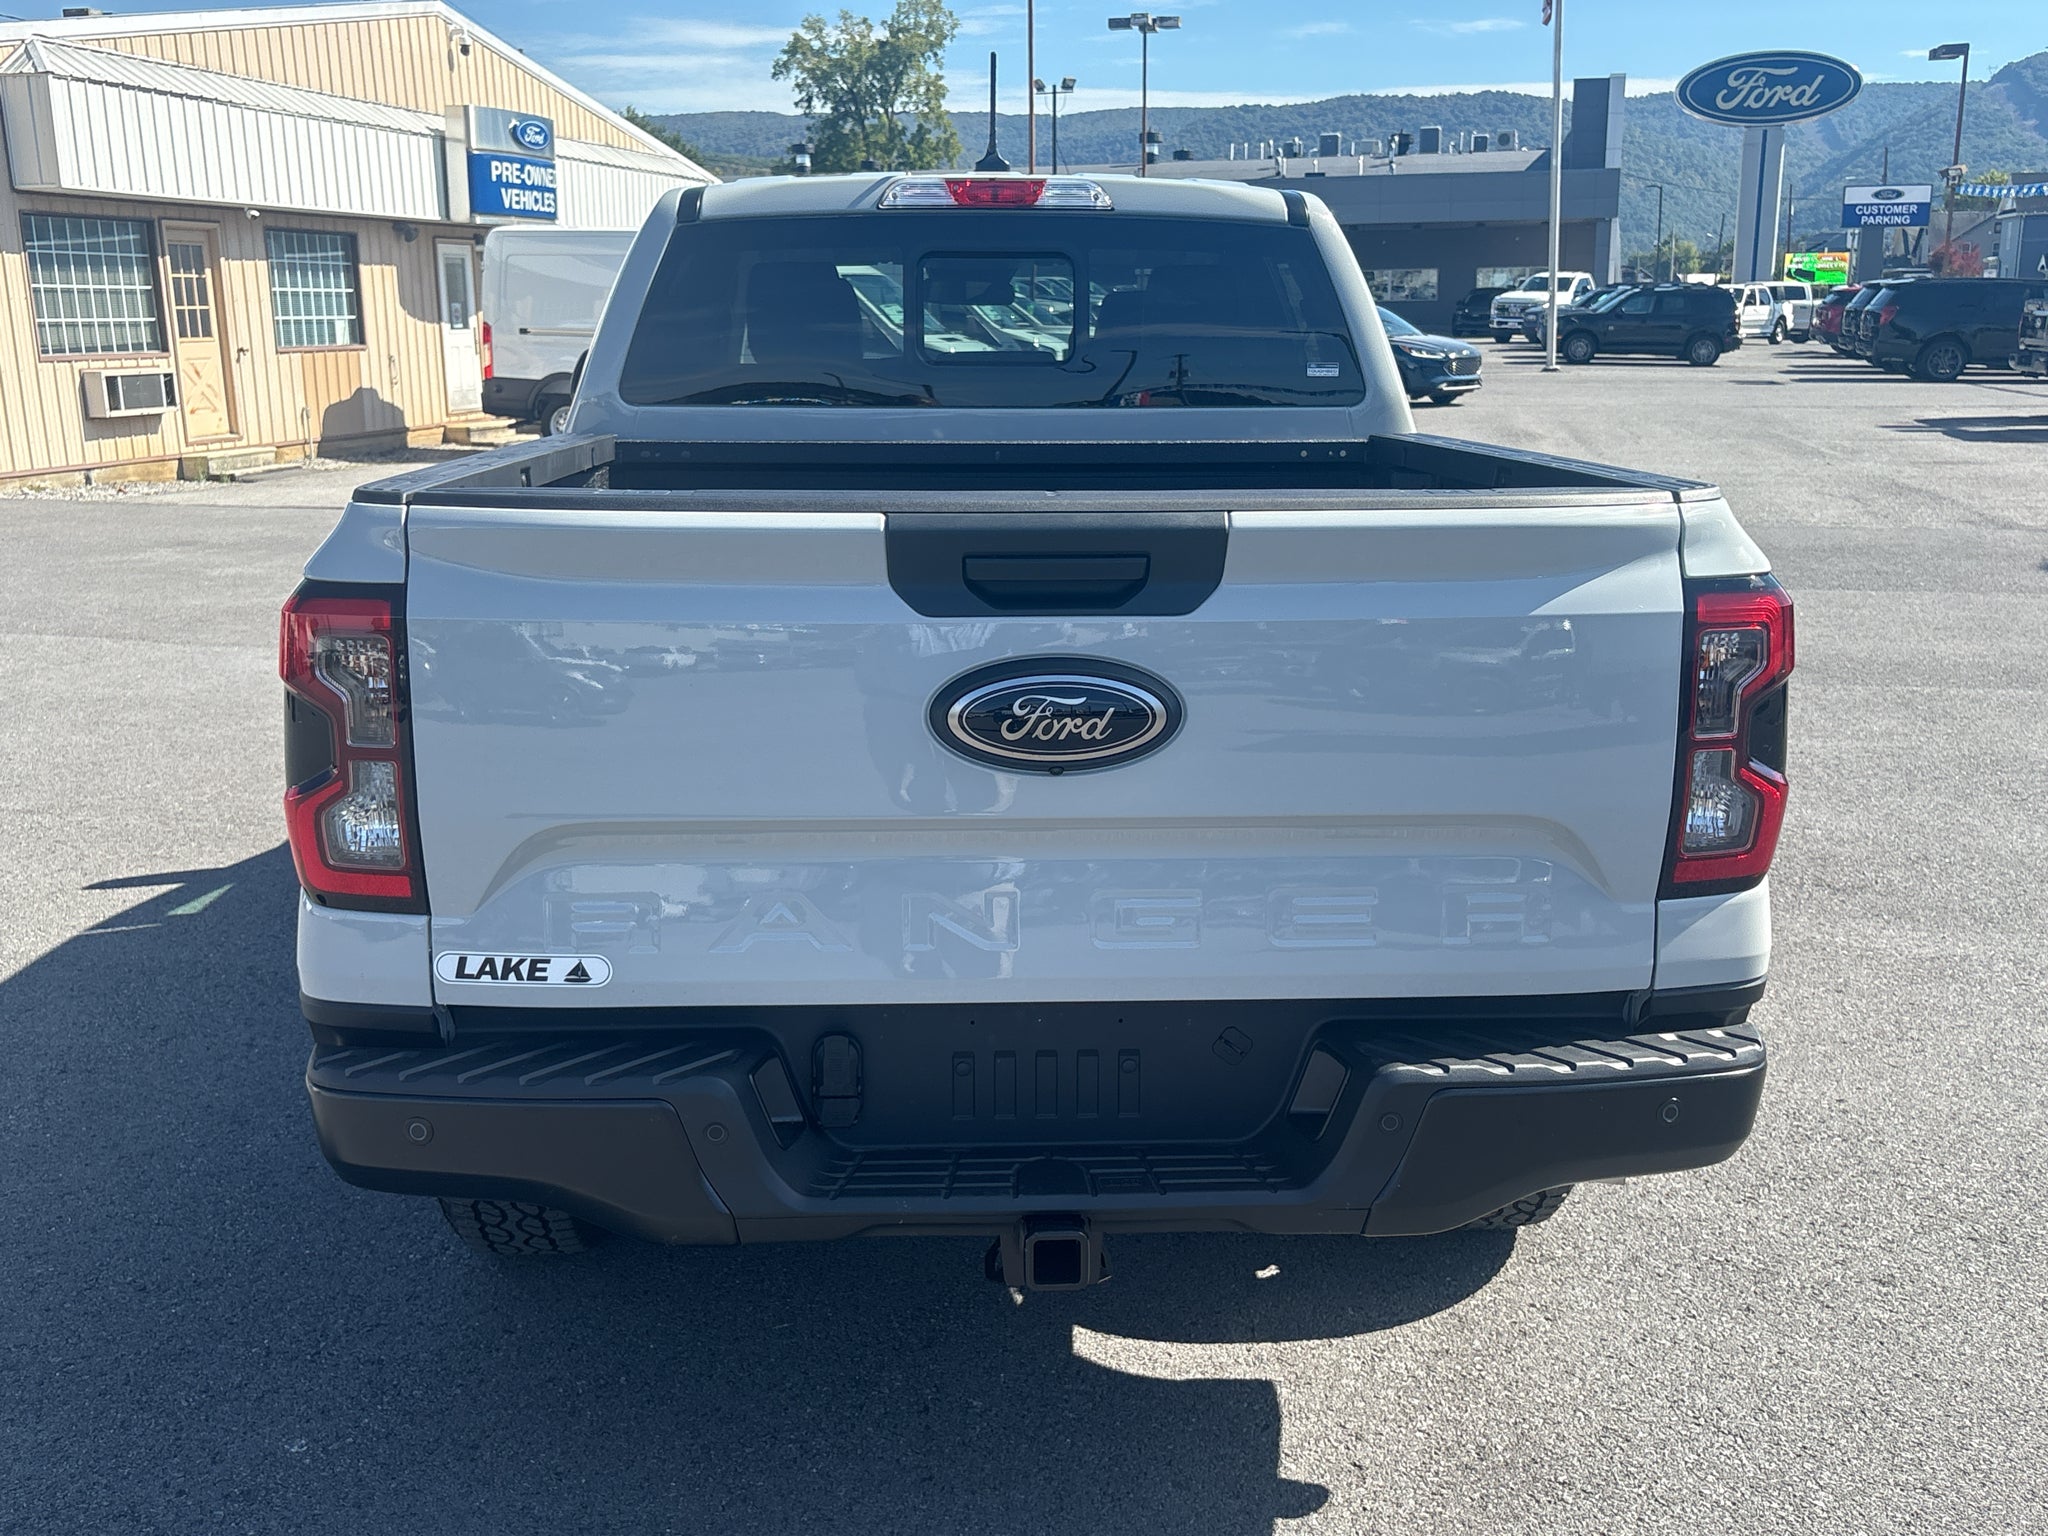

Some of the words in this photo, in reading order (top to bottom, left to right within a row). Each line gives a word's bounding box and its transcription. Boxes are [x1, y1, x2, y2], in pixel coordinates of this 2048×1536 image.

[1715, 66, 1825, 111] Ford
[524, 126, 545, 145] Ford
[490, 160, 557, 189] PRE-OWNE
[500, 187, 555, 213] VEHICLES
[1855, 204, 1918, 215] CUSTOMER
[1860, 215, 1910, 225] PARKING
[1000, 694, 1115, 741] Ford
[543, 886, 1552, 953] RANGER
[455, 956, 551, 982] LAKE
